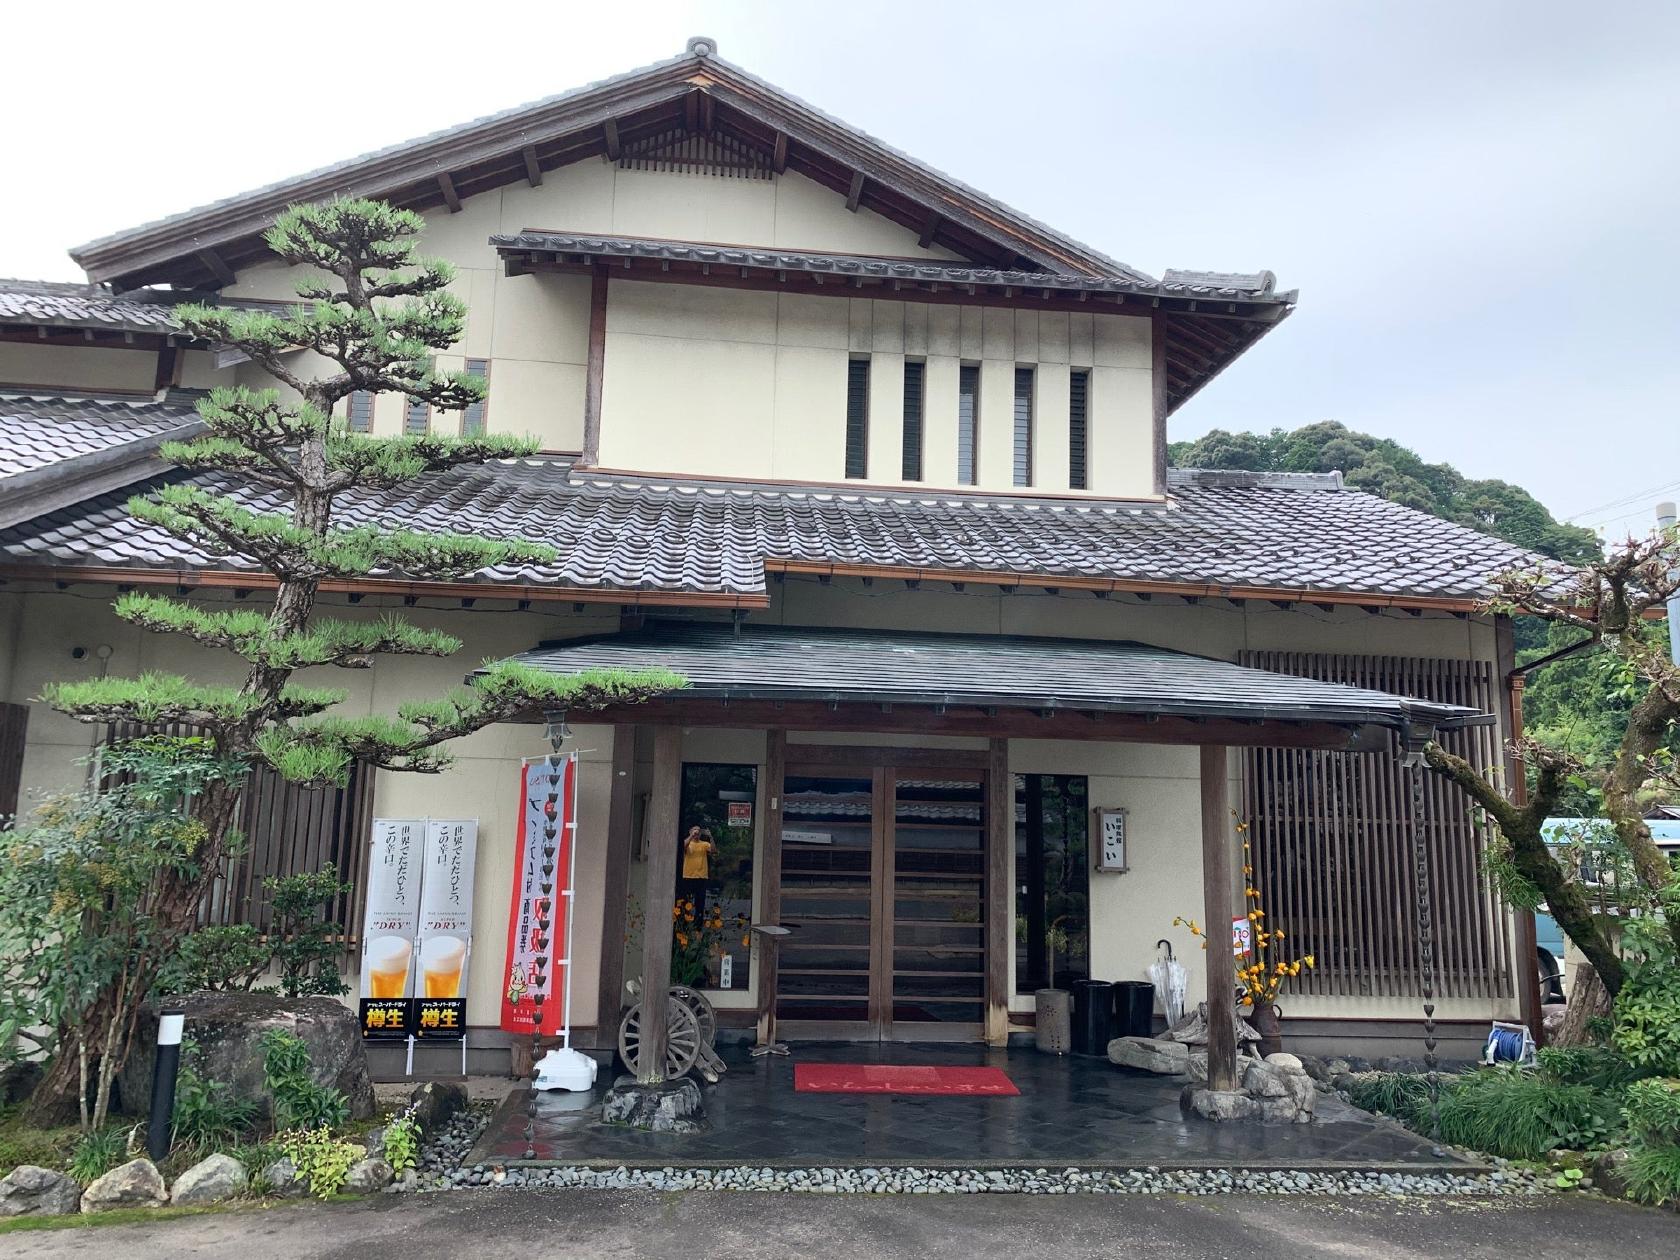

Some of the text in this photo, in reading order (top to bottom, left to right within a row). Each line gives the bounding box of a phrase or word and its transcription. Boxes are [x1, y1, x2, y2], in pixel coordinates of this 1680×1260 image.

[384, 825, 396, 867] この辛口。
[438, 825, 449, 867] この辛口。
[1105, 822, 1116, 861] いこい
[395, 825, 410, 905] 世界でただひとつ、
[449, 825, 464, 905] 世界でただひとつ、
[366, 1008, 404, 1028] 樽生
[420, 1008, 458, 1028] 樽生
